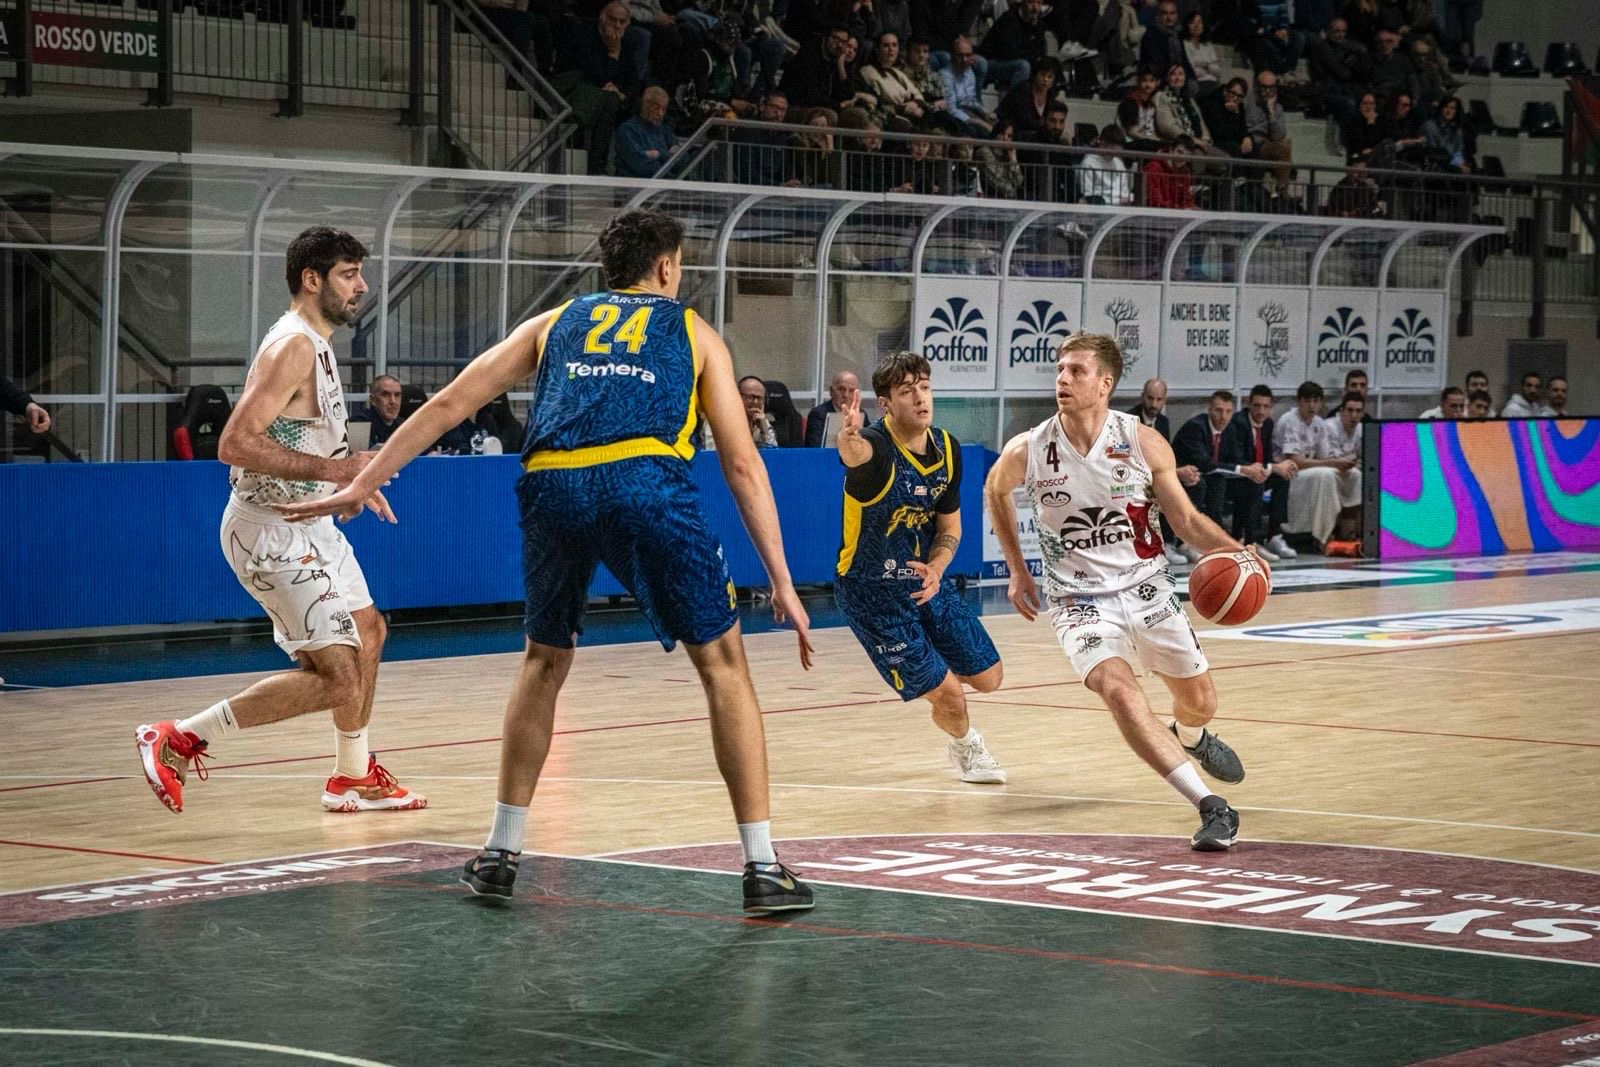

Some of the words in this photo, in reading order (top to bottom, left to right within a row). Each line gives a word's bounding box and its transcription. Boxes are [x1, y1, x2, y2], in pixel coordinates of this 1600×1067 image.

[35, 24, 96, 52] ROSSO
[100, 30, 158, 57] VERDE
[1170, 303, 1197, 321] ANCHE
[1199, 304, 1207, 321] IL
[1209, 304, 1230, 322] BENE
[584, 303, 653, 355] 24
[1187, 329, 1208, 347] DEVE
[1210, 329, 1230, 347] FARE
[923, 336, 988, 364] paffoni
[1009, 337, 1058, 367] paffo
[1317, 341, 1368, 368] paffoni
[1385, 341, 1434, 368] paffoni
[566, 361, 655, 384] Temera
[1199, 354, 1228, 372] CASINO
[1047, 441, 1060, 473] 4
[1037, 477, 1065, 488] BOSCO
[1061, 528, 1134, 552] paffoni
[992, 563, 1008, 576] Tel.
[1030, 562, 1042, 574] 78
[924, 841, 1157, 867] mestiere
[1159, 863, 1343, 886] nostro
[1339, 882, 1394, 892] il
[791, 850, 1600, 944] SYNERGIE
